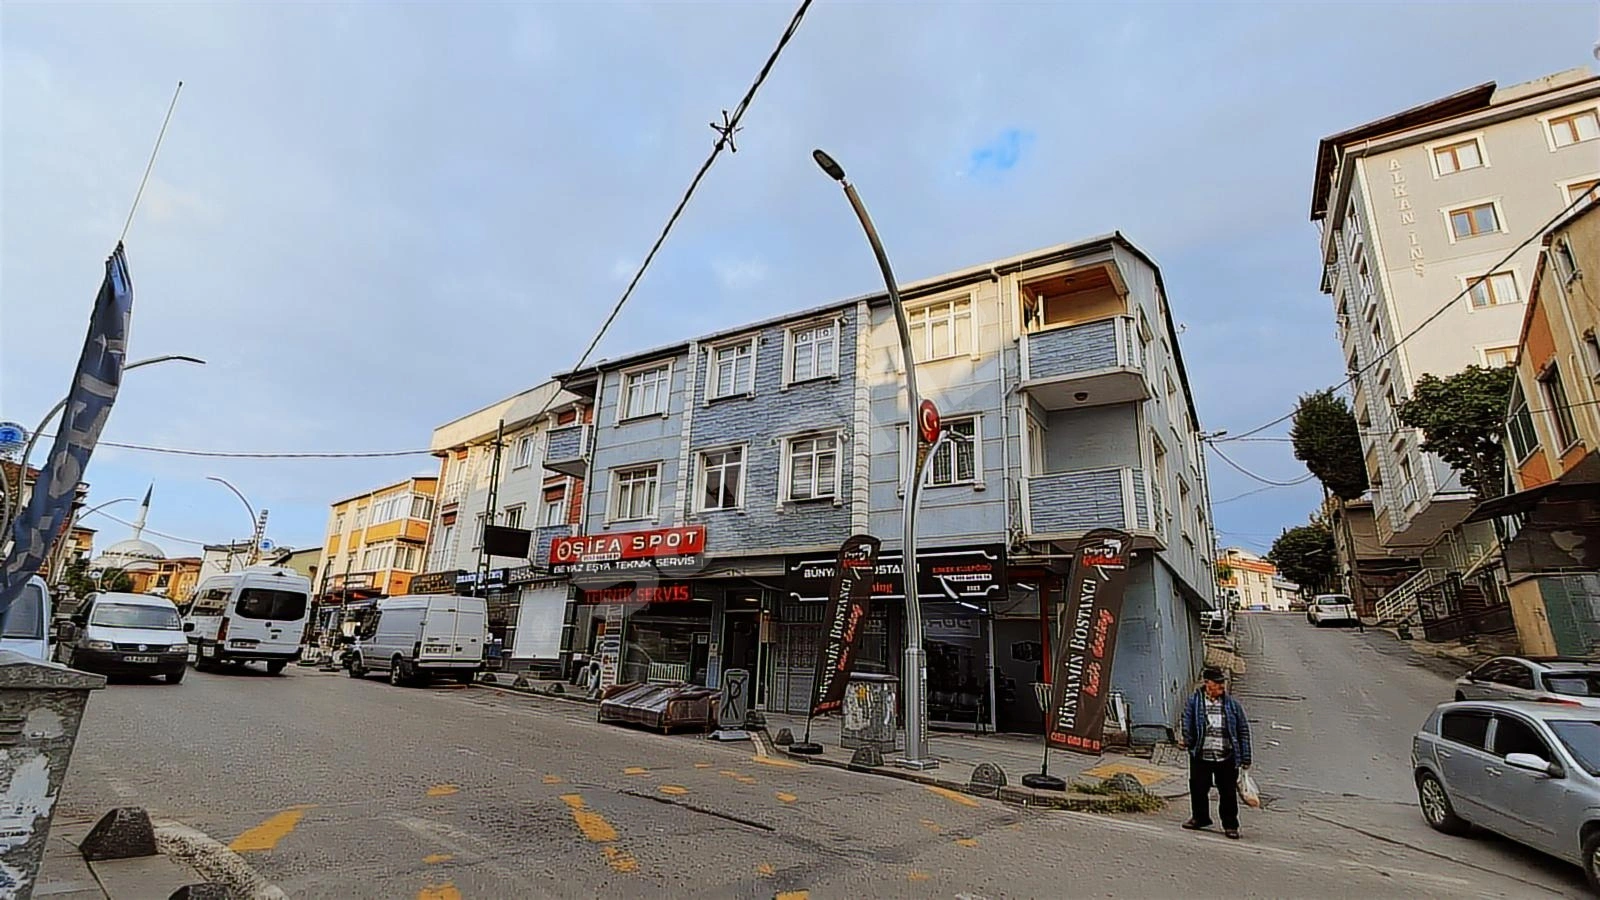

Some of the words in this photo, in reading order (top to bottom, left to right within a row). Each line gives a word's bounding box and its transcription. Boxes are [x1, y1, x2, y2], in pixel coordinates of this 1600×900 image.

[632, 531, 698, 550] SPOT
[553, 563, 583, 574] BEYAZ
[586, 562, 611, 573] EŞYA
[615, 557, 653, 571] TEKNİK
[655, 554, 695, 567] SERVİS
[636, 582, 689, 602] SERVİS
[1069, 578, 1097, 651] BOSTANCI
[1058, 653, 1085, 729] BÜNYAMİN
